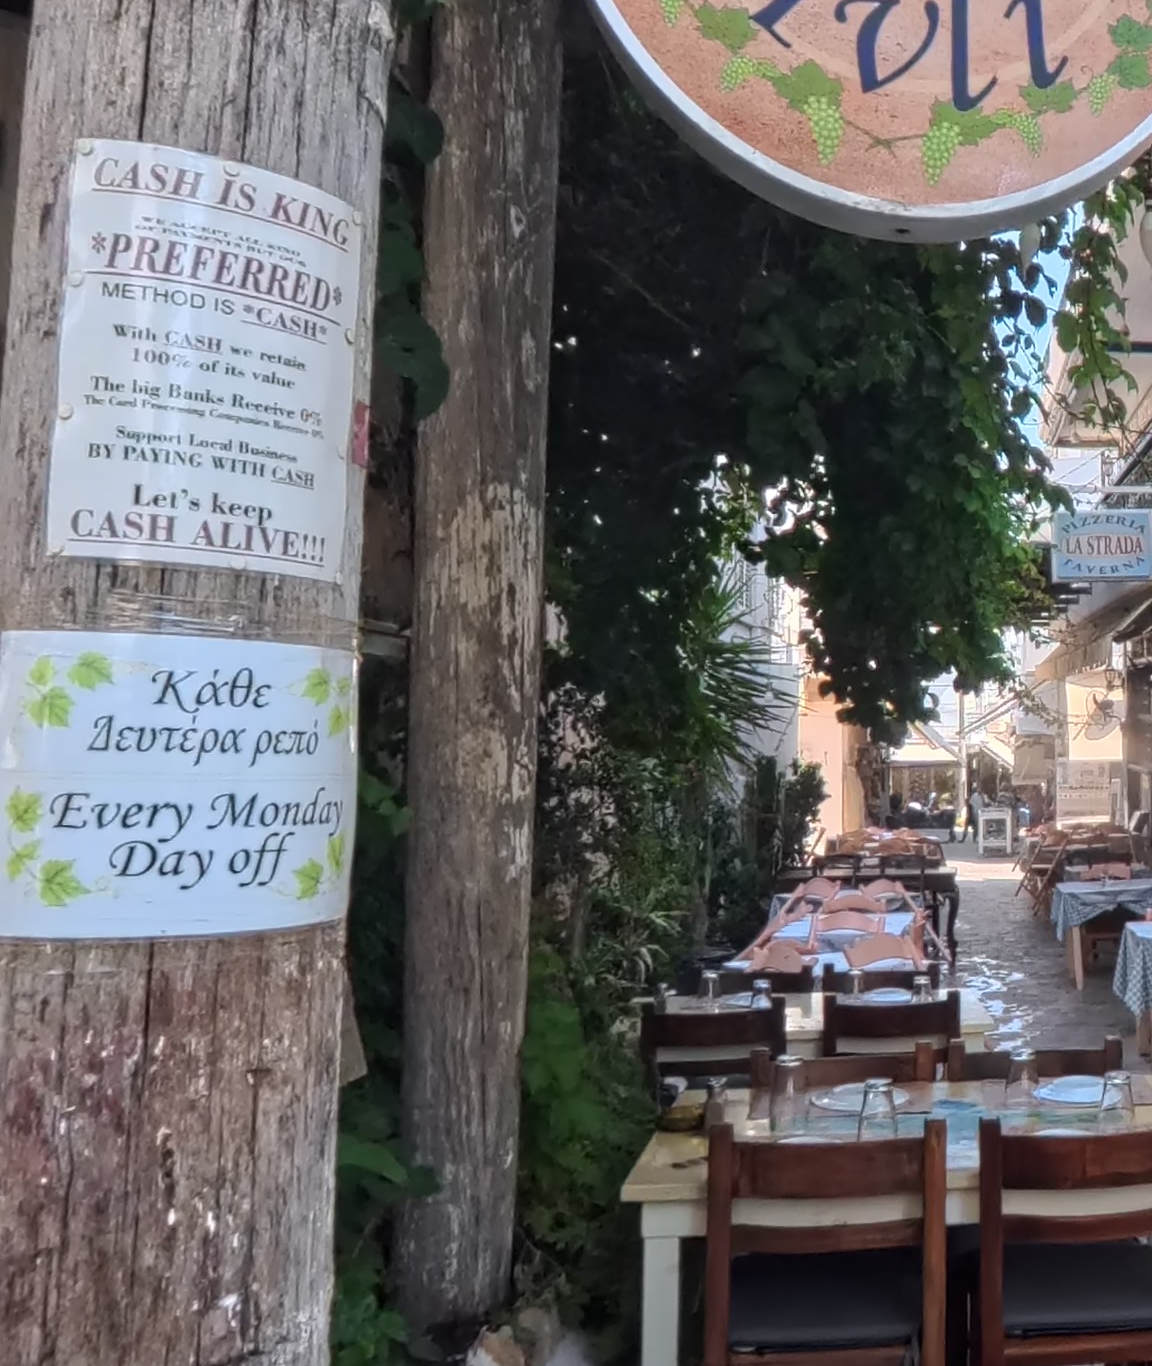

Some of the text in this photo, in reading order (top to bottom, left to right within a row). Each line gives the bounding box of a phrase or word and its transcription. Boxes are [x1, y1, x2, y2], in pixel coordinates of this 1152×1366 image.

[94, 156, 350, 246] CASH IS KING
[101, 281, 206, 310] METHOD
[213, 297, 236, 315] IS
[112, 323, 157, 342] With
[164, 330, 224, 352] CASH
[229, 344, 254, 357] we
[131, 347, 297, 389] 100% of its value
[83, 394, 106, 406] The
[90, 376, 323, 426] The big Banks Receive 0%
[116, 425, 299, 463] Support Local Business
[87, 443, 315, 488] BY PAYING WITH CASH
[211, 493, 274, 527] keep
[1061, 514, 1147, 535] PIZZERIA
[70, 508, 327, 564] CASH ALIVE!!!
[1065, 535, 1144, 555] LA STRADA
[1062, 556, 1146, 575] TAVERNA
[151, 667, 272, 714] Κάθε
[86, 714, 321, 768] Δευτέρα ρεπό
[49, 787, 345, 843] Every Monday
[109, 832, 296, 891] Day off
